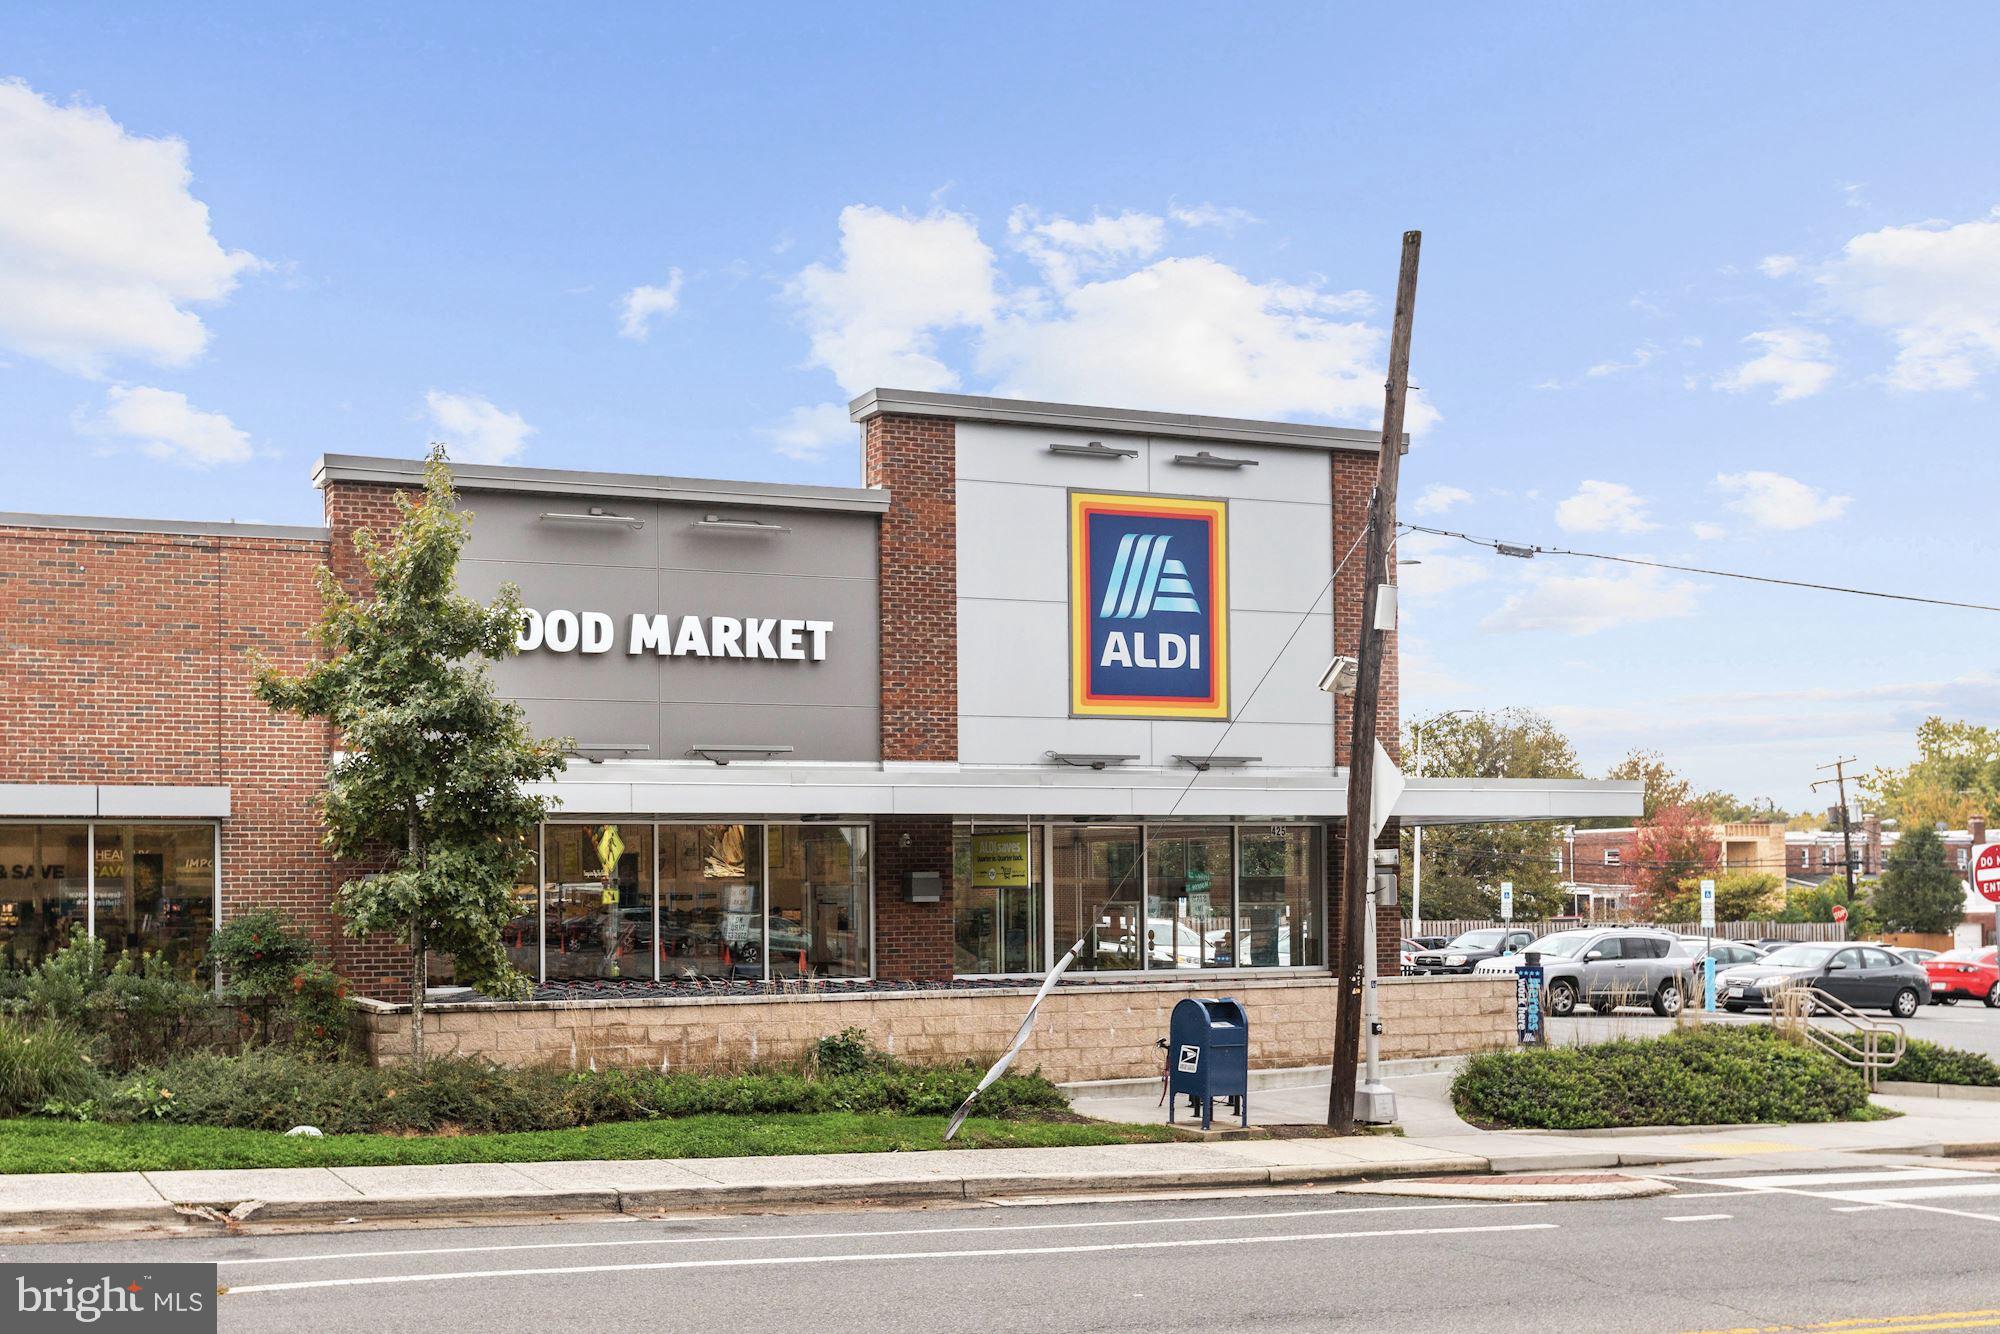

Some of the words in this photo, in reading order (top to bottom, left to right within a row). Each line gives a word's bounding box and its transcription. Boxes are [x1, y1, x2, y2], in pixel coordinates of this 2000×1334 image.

[507, 607, 614, 654] OOD
[630, 613, 834, 661] MARKET
[1100, 631, 1200, 670] ALDI
[1271, 825, 1286, 836] 425
[12, 864, 66, 879] SAVE
[1980, 856, 1993, 868] DO
[1518, 978, 1528, 1006] work
[1528, 977, 1541, 1031] Heroes
[1518, 1007, 1527, 1031] here
